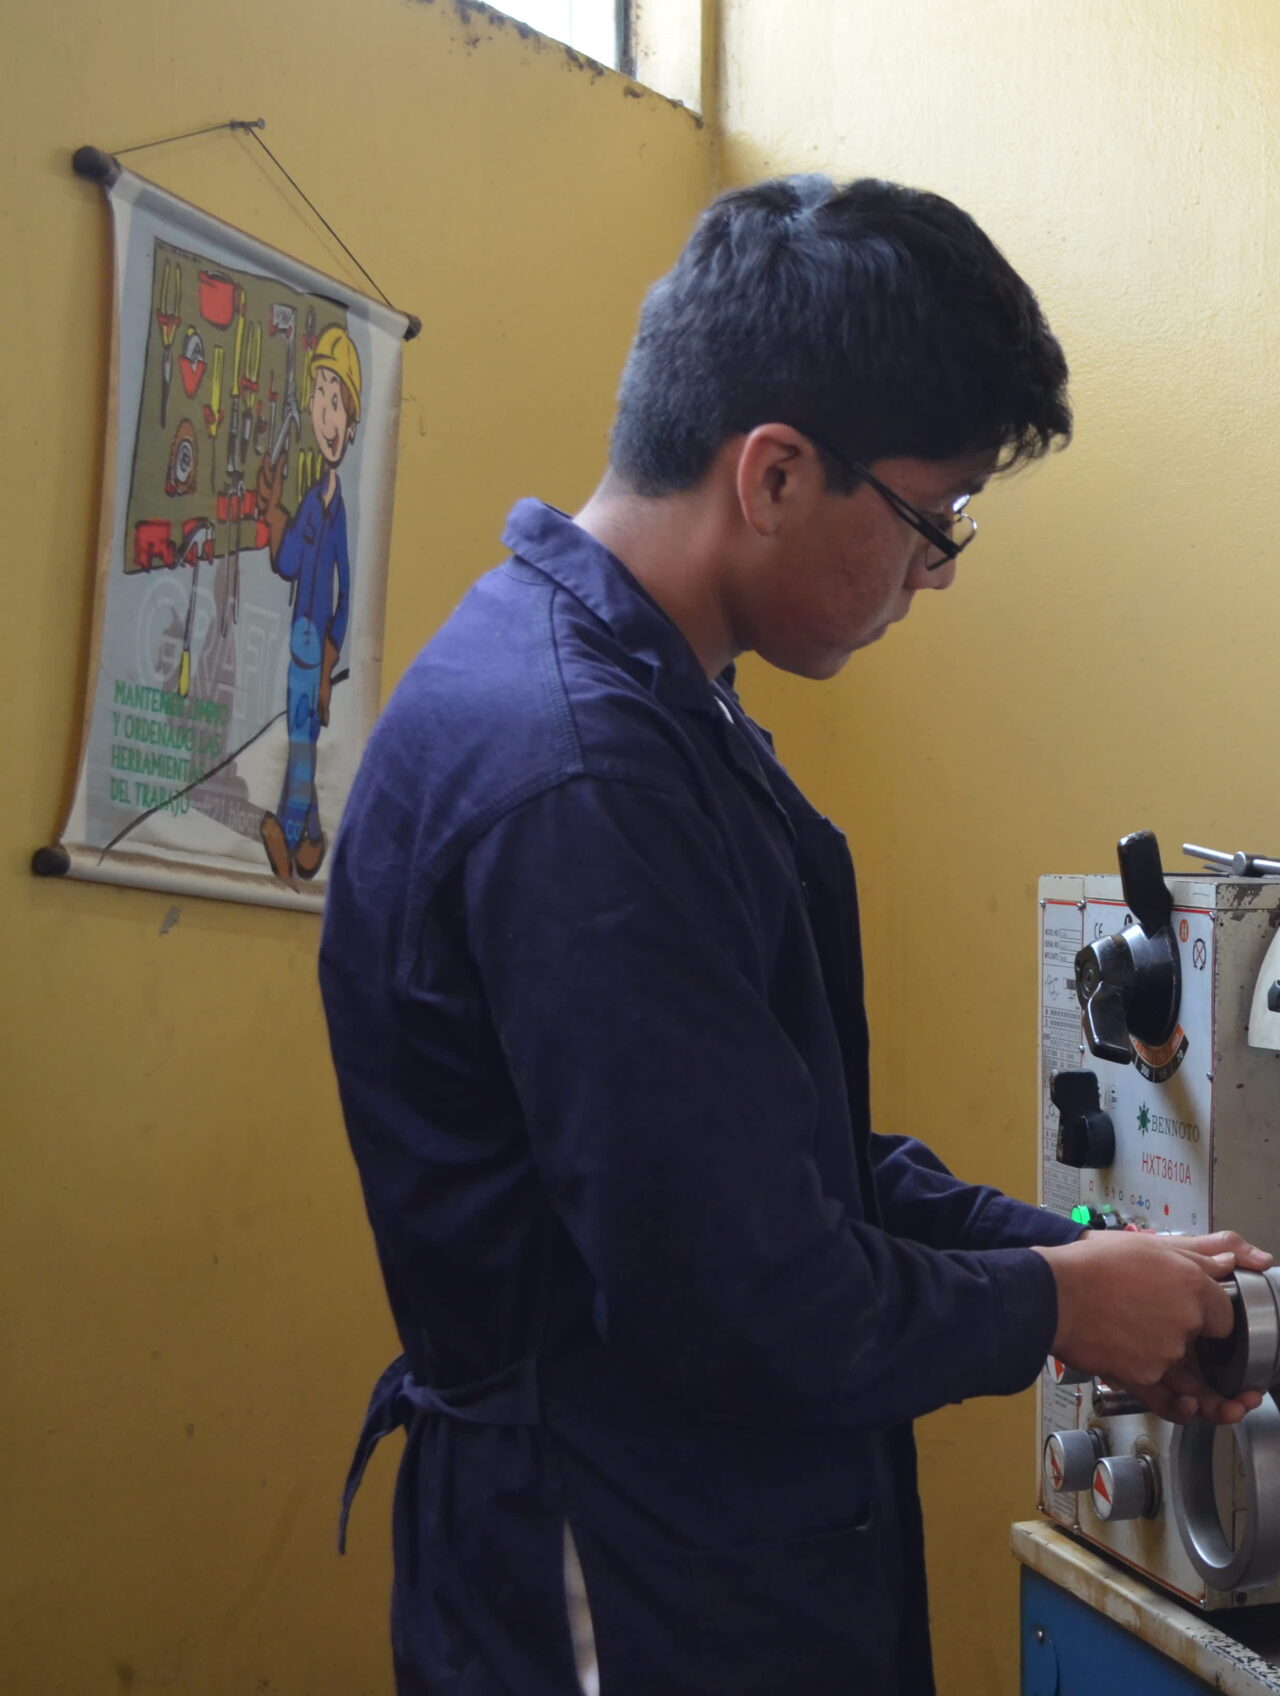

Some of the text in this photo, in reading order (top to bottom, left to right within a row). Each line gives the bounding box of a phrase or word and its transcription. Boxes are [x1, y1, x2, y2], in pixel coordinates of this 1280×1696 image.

[112, 711, 121, 737] Y
[124, 715, 194, 752] ORDENADO
[110, 776, 131, 805] DEL
[135, 781, 191, 818] TRABAJO
[1150, 1113, 1200, 1143] BENNOTO
[1142, 1152, 1192, 1185] HXT3610A
